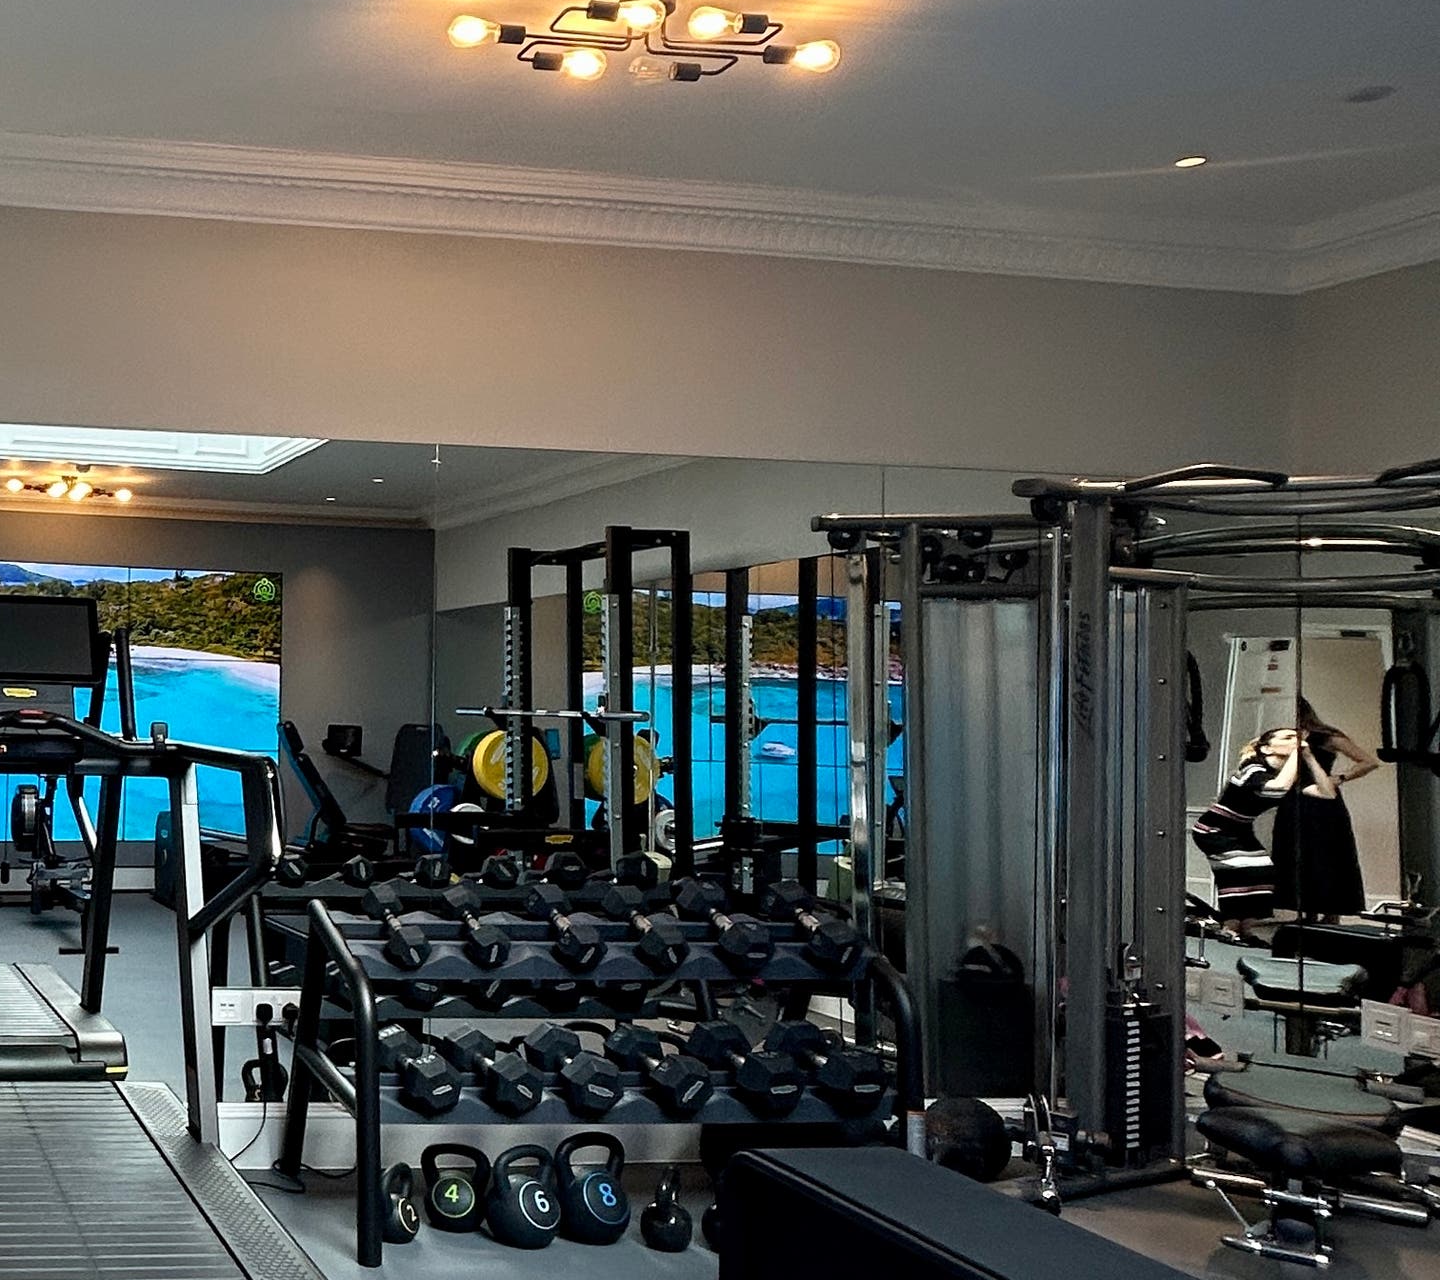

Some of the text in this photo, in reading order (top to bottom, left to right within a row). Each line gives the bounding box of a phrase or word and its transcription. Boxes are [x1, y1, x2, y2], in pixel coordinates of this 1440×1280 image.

[445, 1184, 459, 1203] 4
[534, 1190, 550, 1213] 6
[599, 1183, 617, 1206] 8
[407, 1205, 417, 1222] 2
